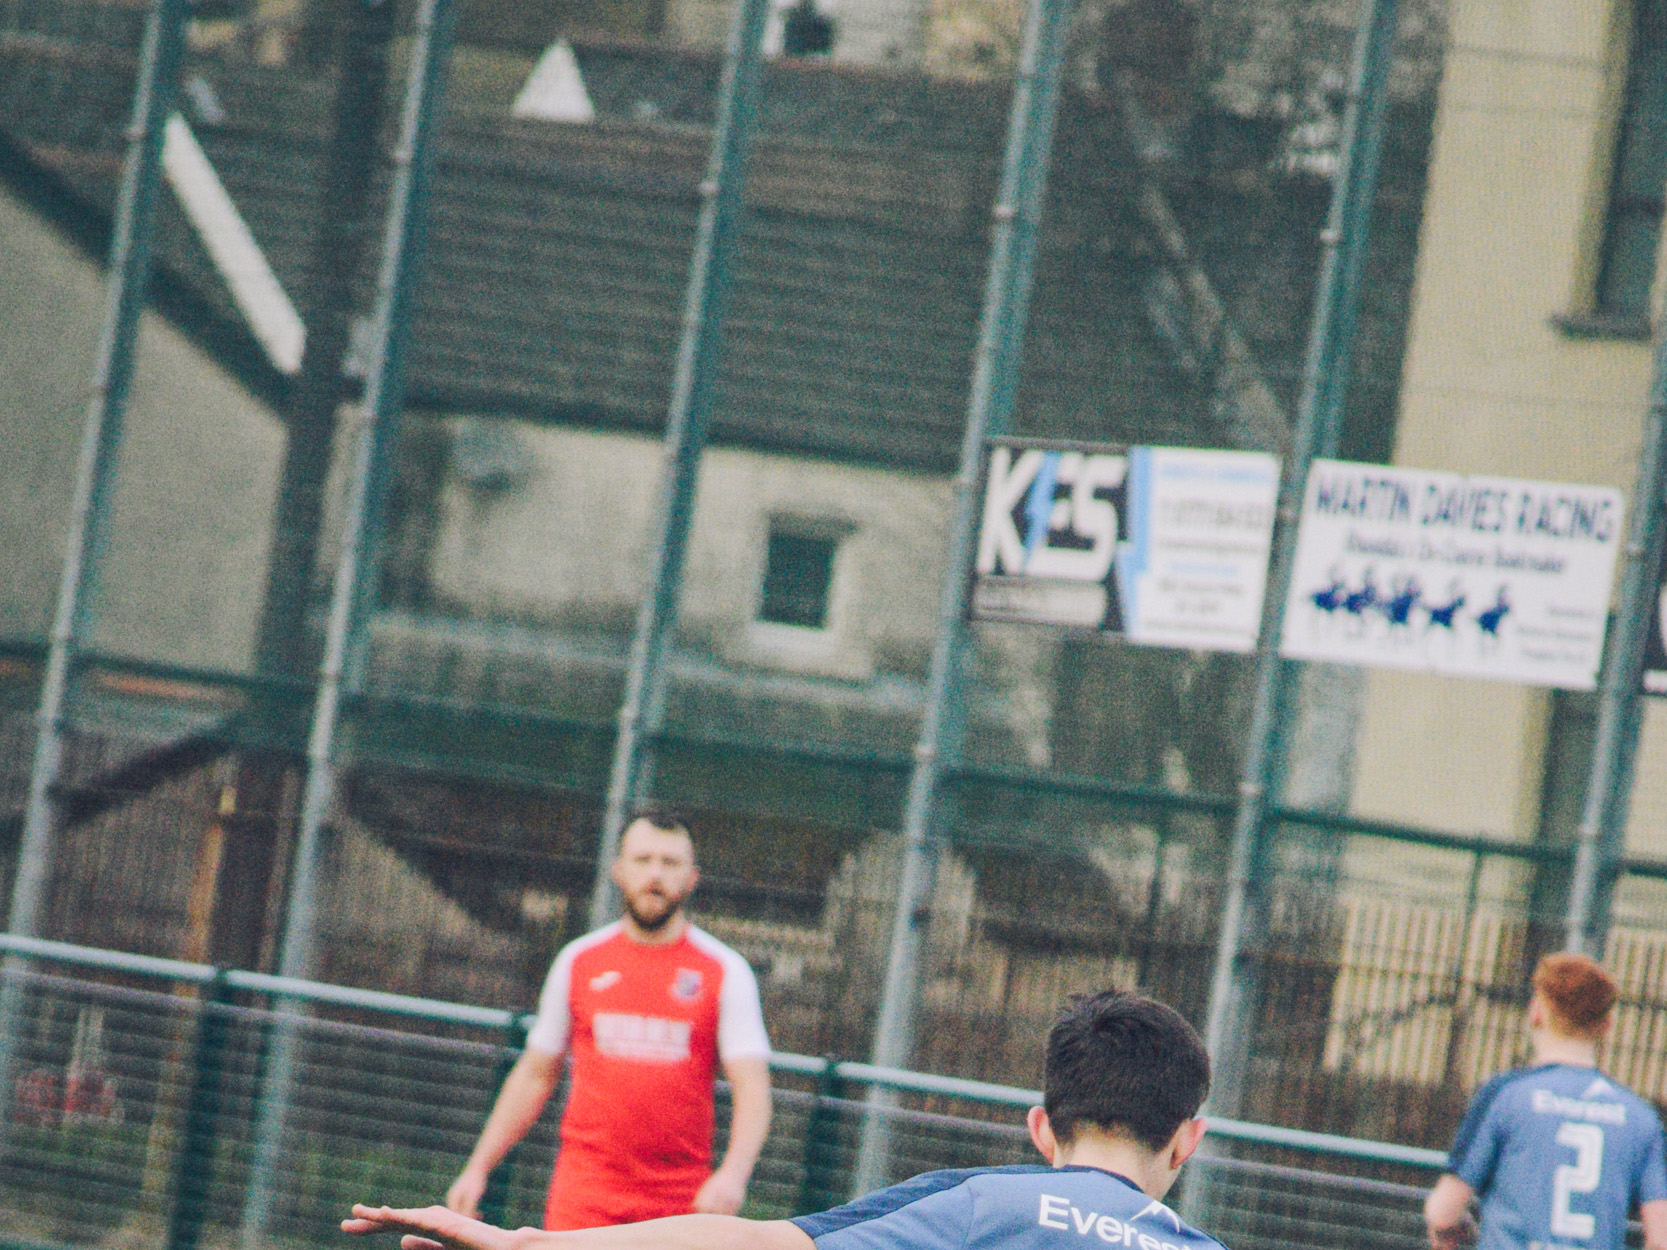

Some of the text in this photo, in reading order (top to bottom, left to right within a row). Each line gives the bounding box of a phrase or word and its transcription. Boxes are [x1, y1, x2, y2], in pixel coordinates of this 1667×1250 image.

[1315, 475, 1411, 523] MARTIN
[1420, 482, 1508, 532] DAVIES
[1517, 492, 1612, 544] RACING
[1555, 1121, 1604, 1239] 2
